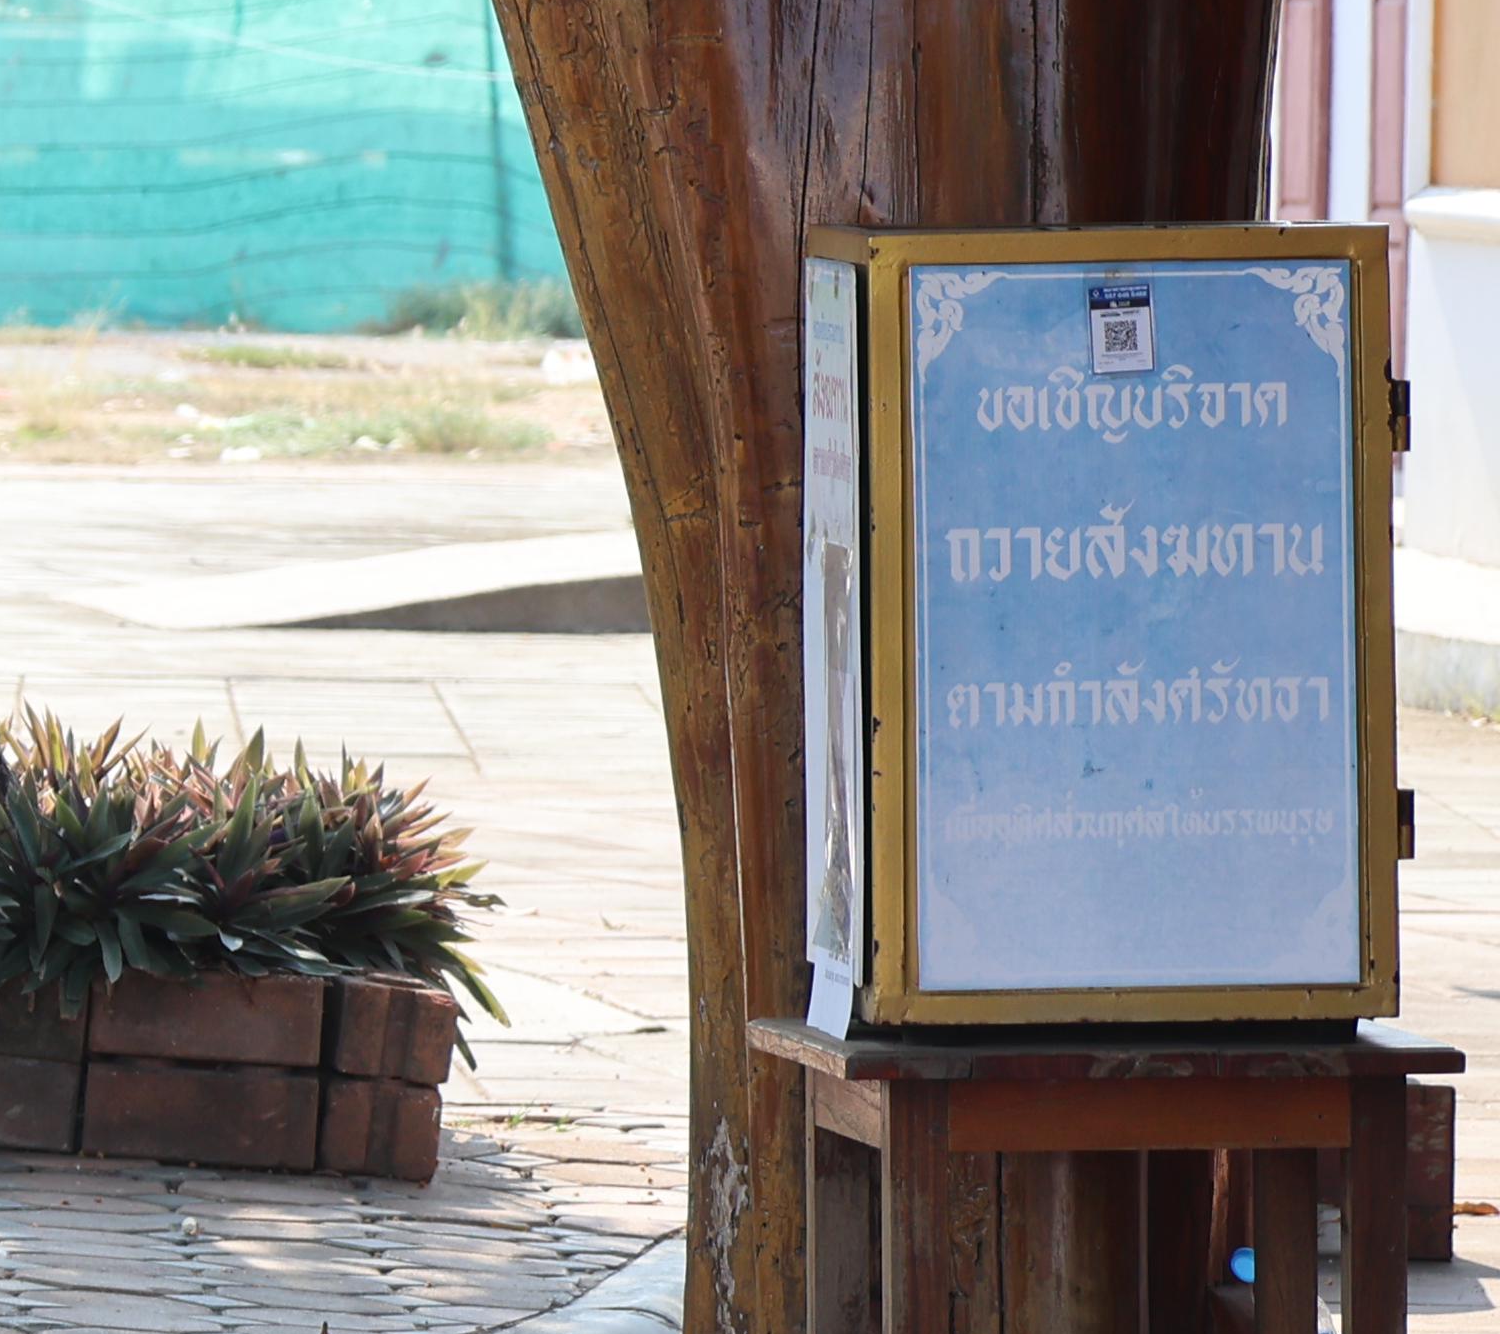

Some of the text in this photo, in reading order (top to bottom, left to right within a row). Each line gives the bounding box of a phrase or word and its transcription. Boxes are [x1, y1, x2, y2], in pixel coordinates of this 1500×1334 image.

[976, 364, 1288, 444] ขอเชิญบริจาค
[946, 654, 1329, 729] ตามกำลังศรัทธา
